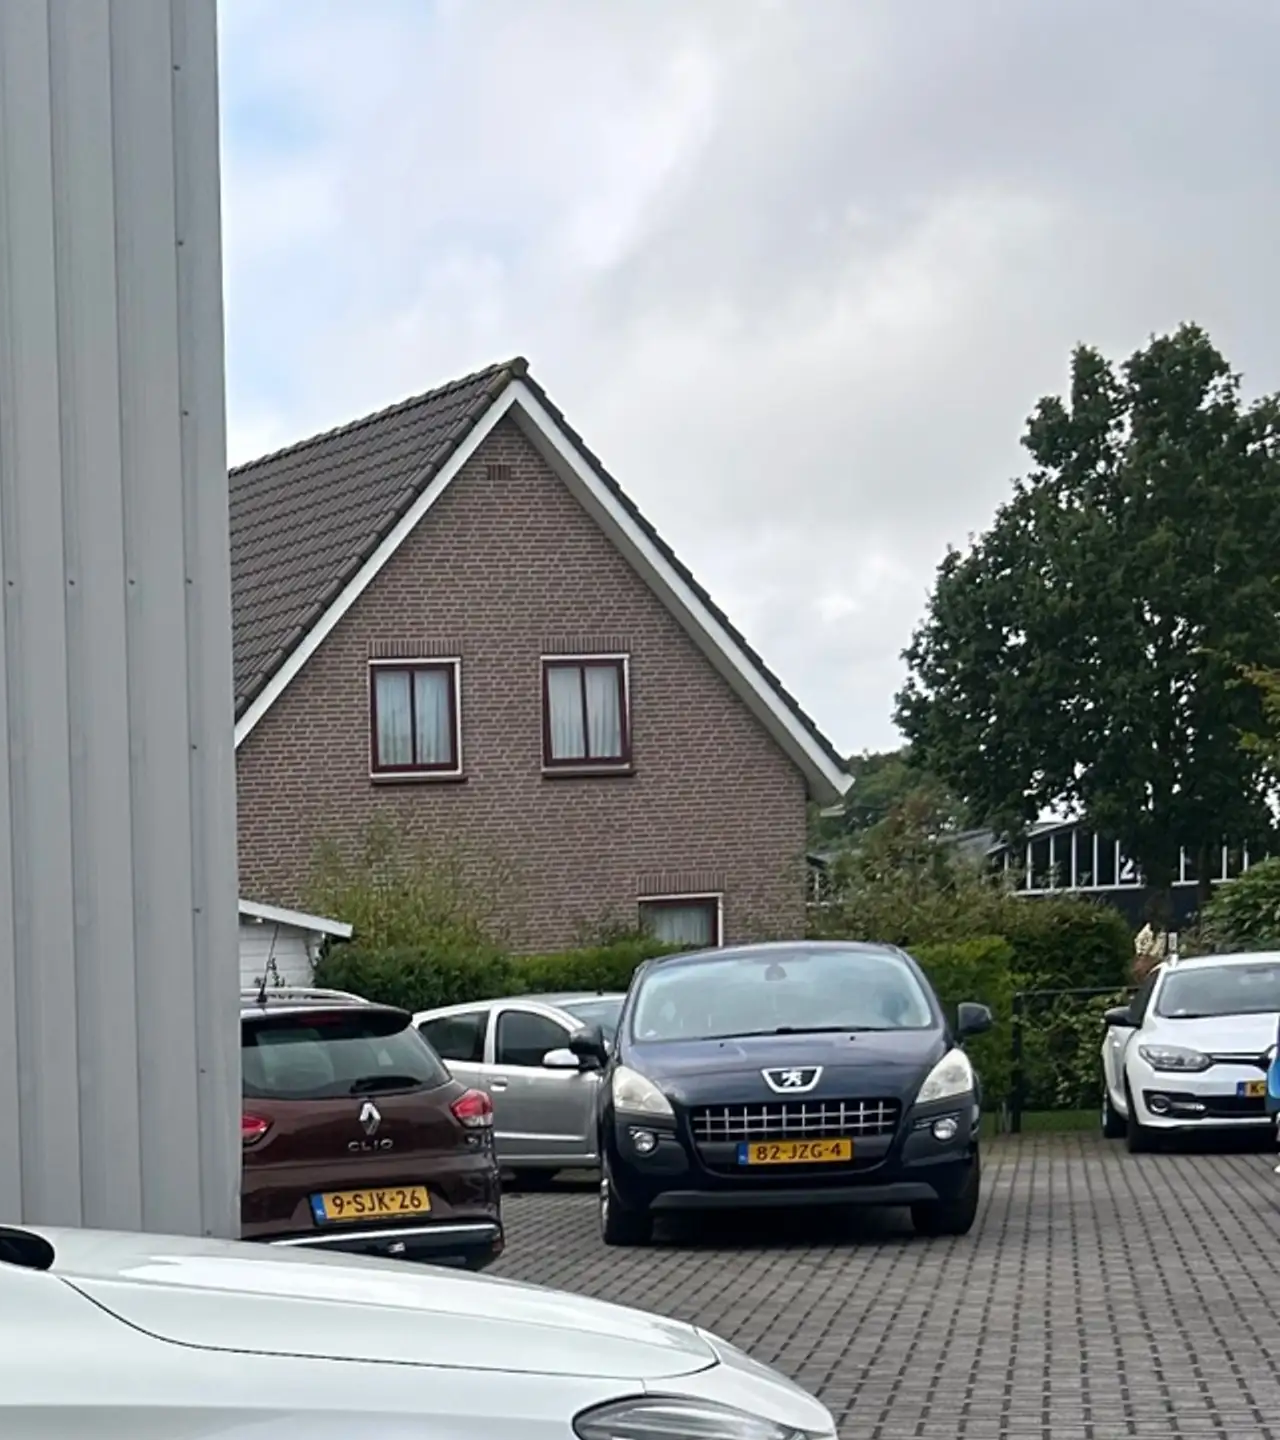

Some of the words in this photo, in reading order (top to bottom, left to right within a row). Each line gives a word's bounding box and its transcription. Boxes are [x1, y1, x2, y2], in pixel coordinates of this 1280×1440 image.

[348, 1138, 393, 1152] CLIO
[756, 1142, 842, 1161] 82-JZG-4
[331, 1189, 422, 1215] 9-SJK-26
